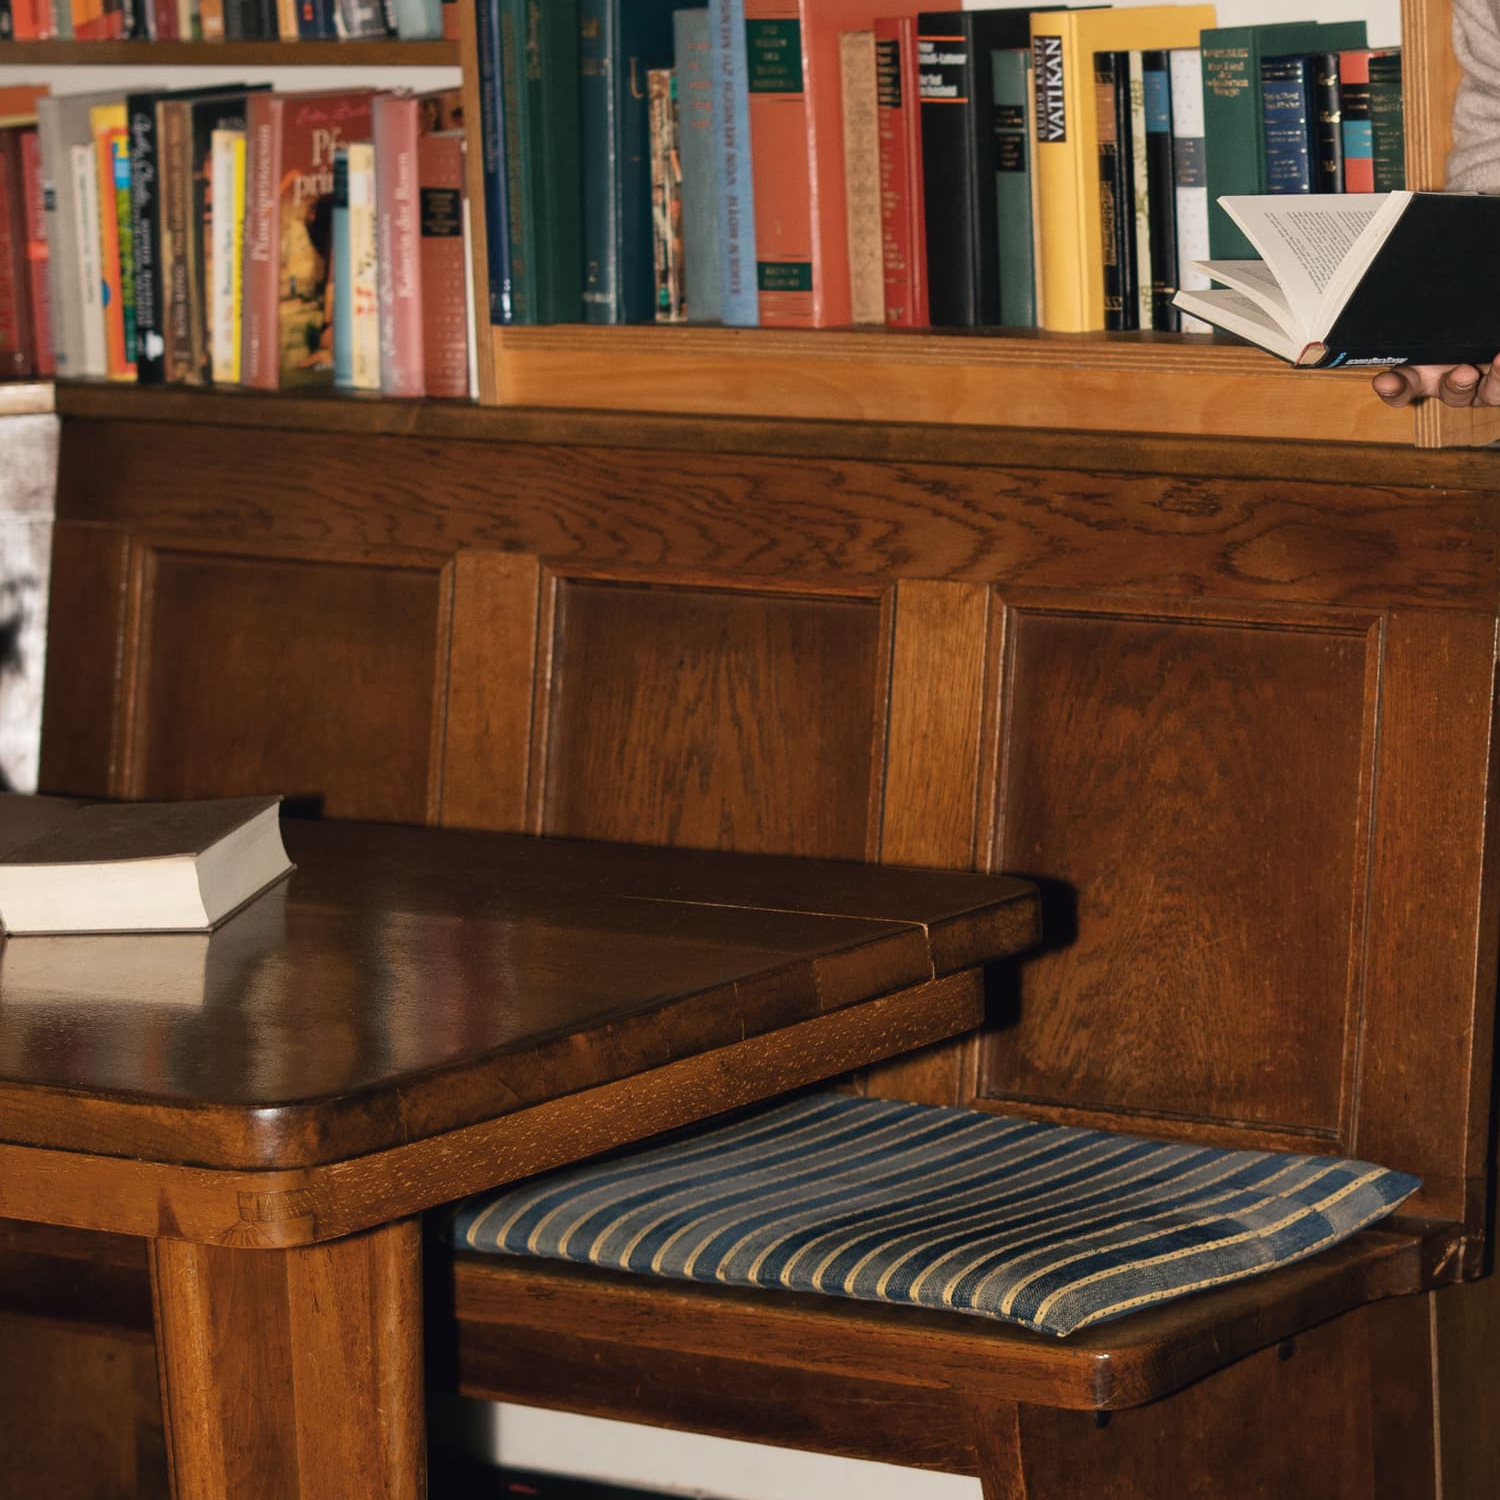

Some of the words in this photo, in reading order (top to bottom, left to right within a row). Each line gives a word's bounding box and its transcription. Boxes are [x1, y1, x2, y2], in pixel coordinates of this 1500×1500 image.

[1034, 39, 1045, 85] KNOPP
[1044, 39, 1065, 140] VATIKAN
[1036, 91, 1047, 139] GUIDO
